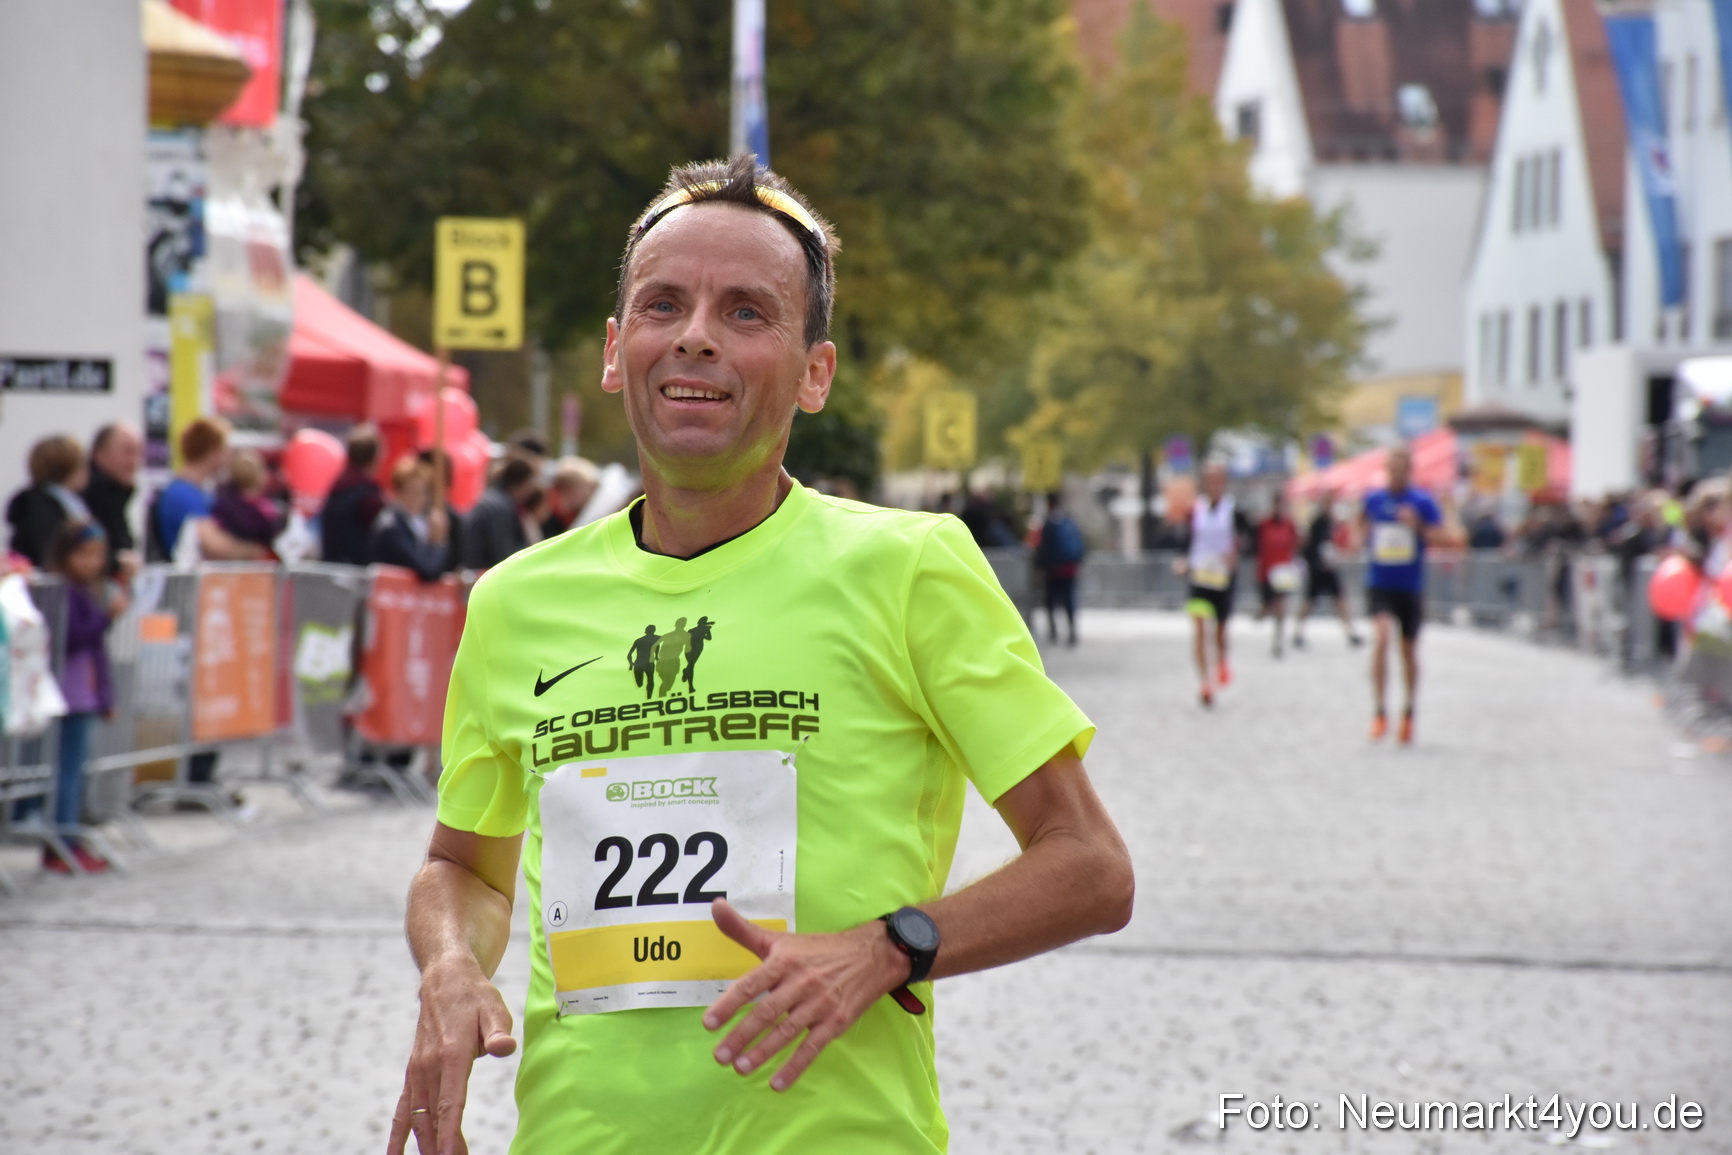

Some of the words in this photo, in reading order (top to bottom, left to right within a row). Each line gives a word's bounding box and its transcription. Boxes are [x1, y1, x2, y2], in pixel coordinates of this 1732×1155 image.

[461, 260, 499, 317] B
[533, 715, 566, 739] SC
[632, 777, 718, 800] BOCK
[631, 801, 657, 809] inspired
[594, 831, 728, 910] 222
[554, 907, 562, 921] A
[633, 935, 682, 962] Udo
